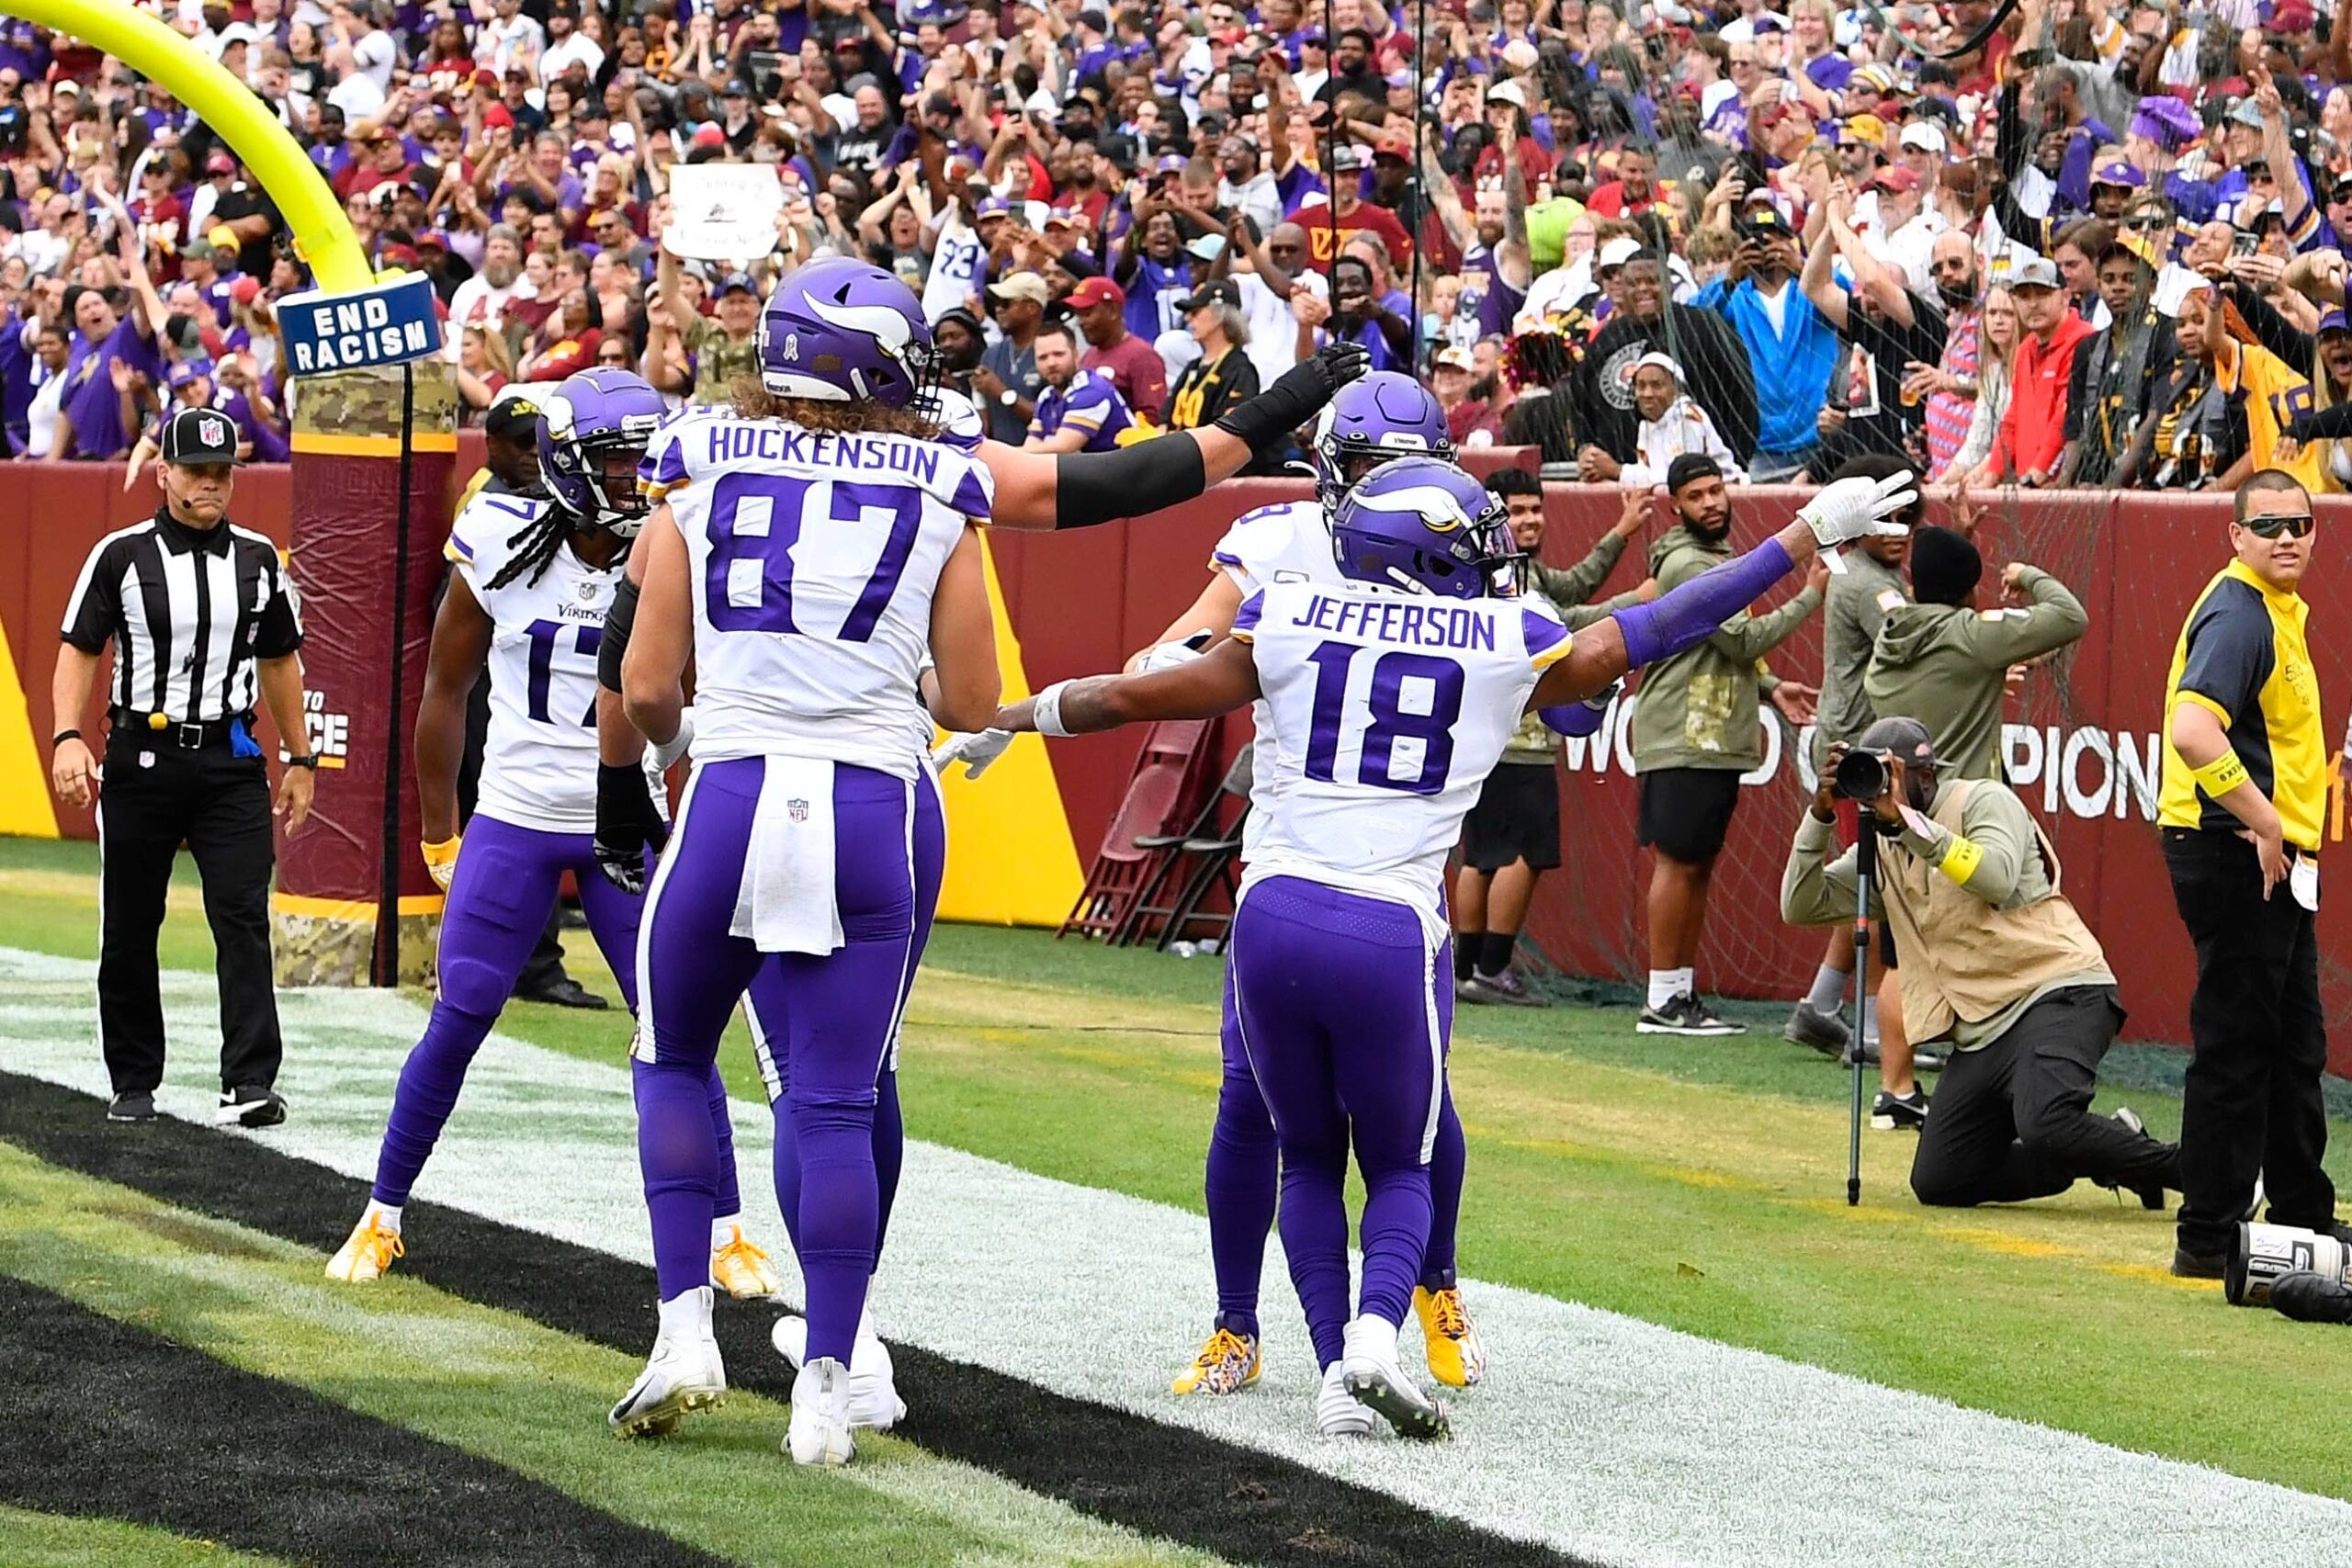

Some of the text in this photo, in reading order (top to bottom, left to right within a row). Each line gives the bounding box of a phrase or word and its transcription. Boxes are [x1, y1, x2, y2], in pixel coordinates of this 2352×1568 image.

[294, 321, 427, 371] RACISM
[313, 298, 389, 337] END
[709, 426, 939, 485] HOCKENSON
[706, 472, 922, 643] 87
[1292, 594, 1496, 651] JEFFERSON
[1304, 639, 1465, 796] 18
[2001, 724, 2160, 821] PION
